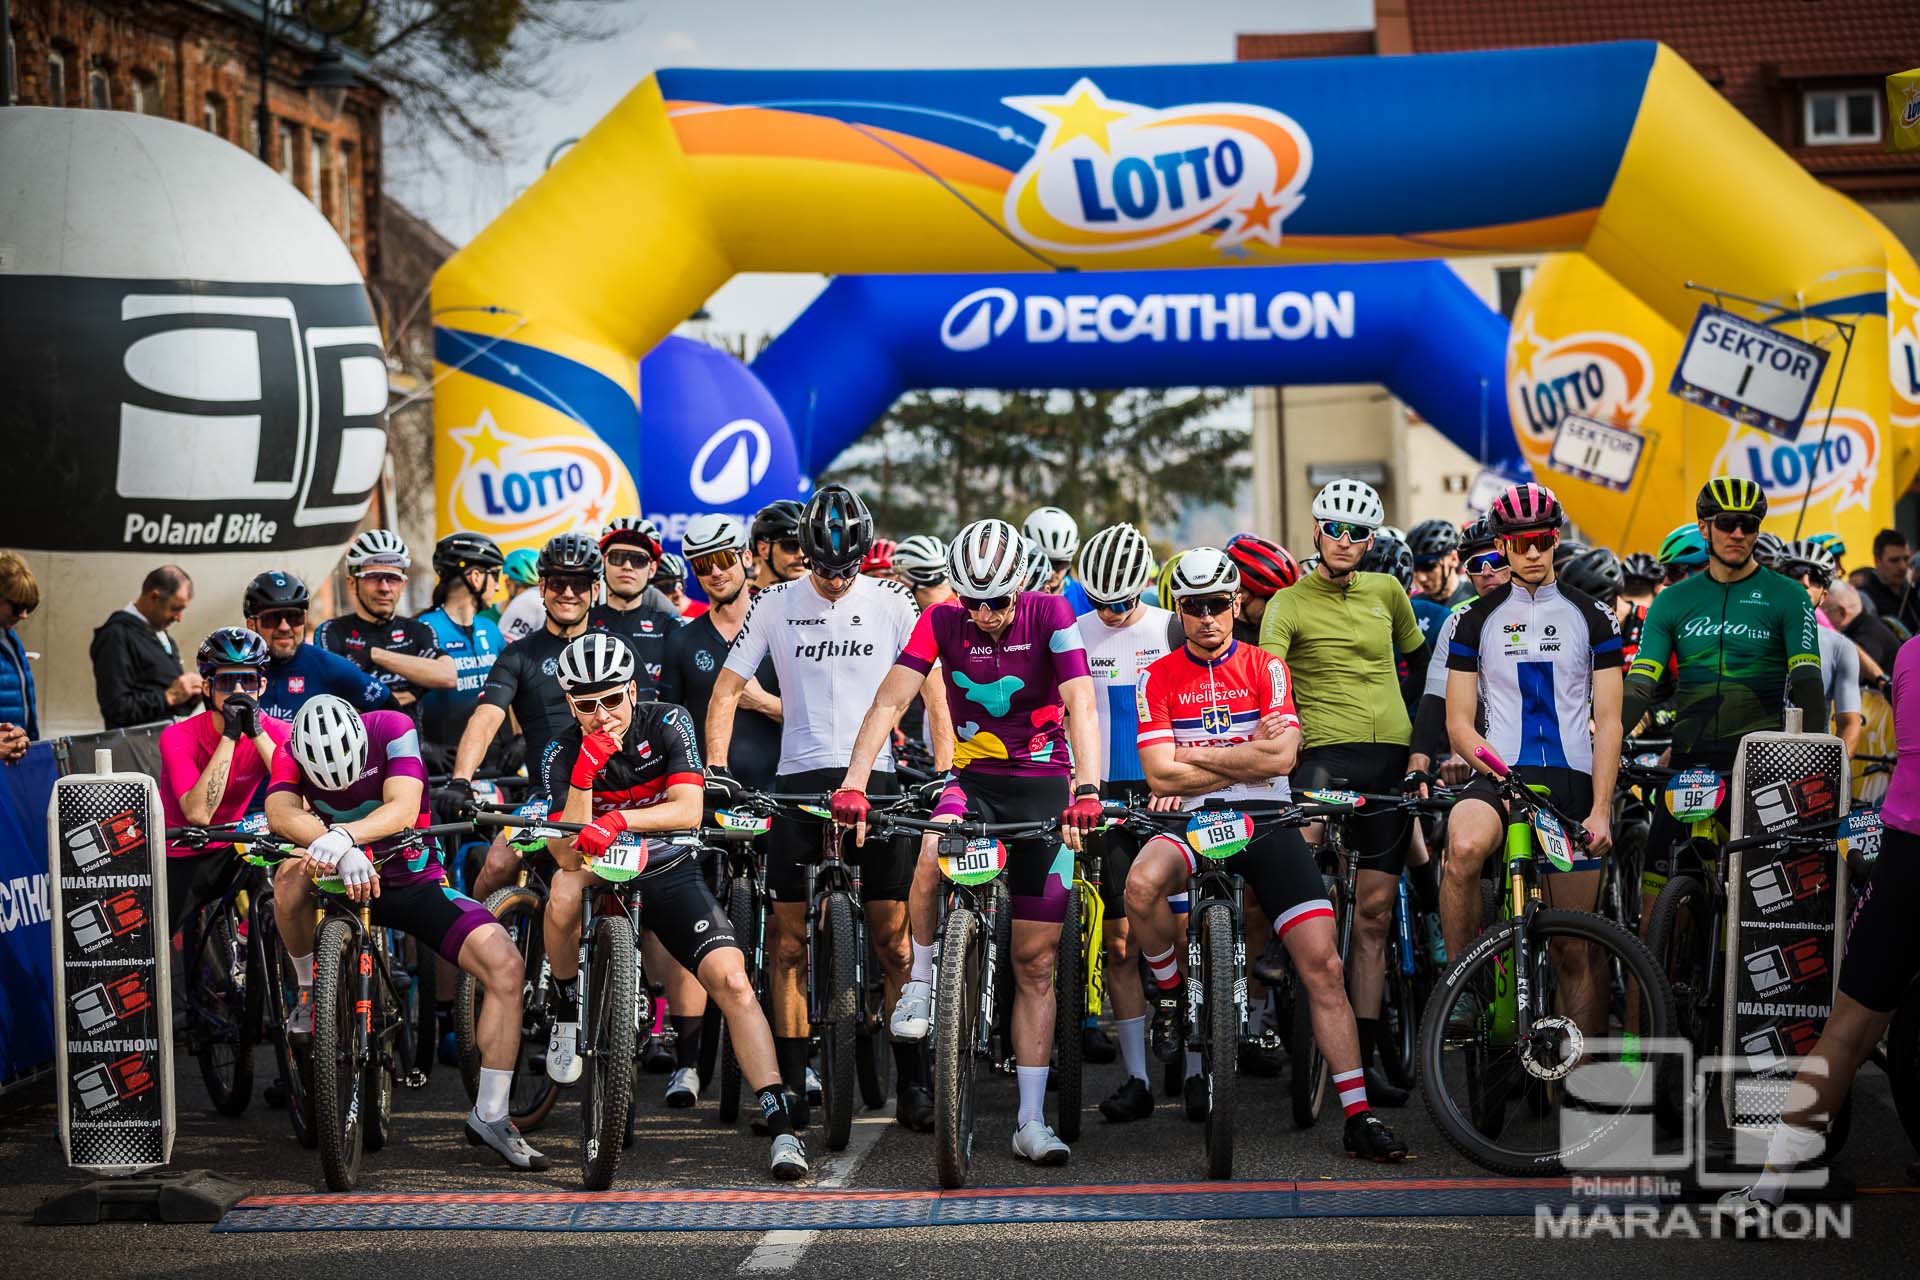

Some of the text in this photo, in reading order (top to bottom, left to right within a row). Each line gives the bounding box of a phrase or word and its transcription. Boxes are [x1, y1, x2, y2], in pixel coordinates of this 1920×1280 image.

[1072, 138, 1244, 223] LOTTO
[1025, 291, 1355, 342] DECATHLON
[1702, 320, 1811, 381] SEKTOR
[1736, 364, 1754, 397] I
[1520, 362, 1605, 433] LOTTO
[1584, 446, 1601, 466] II
[1746, 433, 1852, 489] LOTTO
[479, 463, 583, 515] LOTTO
[124, 512, 278, 544] Poland Bike
[786, 618, 827, 626] TREK
[1503, 623, 1528, 633] SIXT
[1678, 616, 1770, 640] Retro TEAM
[795, 640, 874, 662] rafbike
[969, 646, 993, 655] ANG
[1003, 643, 1032, 652] VERGE
[1539, 644, 1561, 652] WKK
[1091, 659, 1115, 667] WKK
[1178, 688, 1249, 705] Wieliszew
[673, 721, 696, 769] TOYOTA WOLA
[680, 715, 703, 769] CAROLINA
[548, 745, 564, 763] WOLA
[1684, 790, 1703, 808] 96
[1766, 818, 1799, 834] Poland Bike
[1848, 814, 1874, 824] POLAND
[1207, 825, 1236, 844] 198
[81, 857, 112, 874] Poland Bike
[956, 853, 990, 871] 600
[61, 873, 152, 889] MARATHON
[1761, 899, 1794, 916] Poland Bike
[1740, 920, 1834, 931] www.polandbike.pl
[83, 937, 113, 955] Poland Bike
[65, 957, 155, 968] www.polandbike.pl
[1759, 984, 1792, 999] Poland Bike
[1737, 1002, 1831, 1018] MARATHON
[87, 1019, 118, 1037] Poland Bike
[68, 1039, 158, 1053] MARATHON
[107, 1100, 120, 1110] Bike
